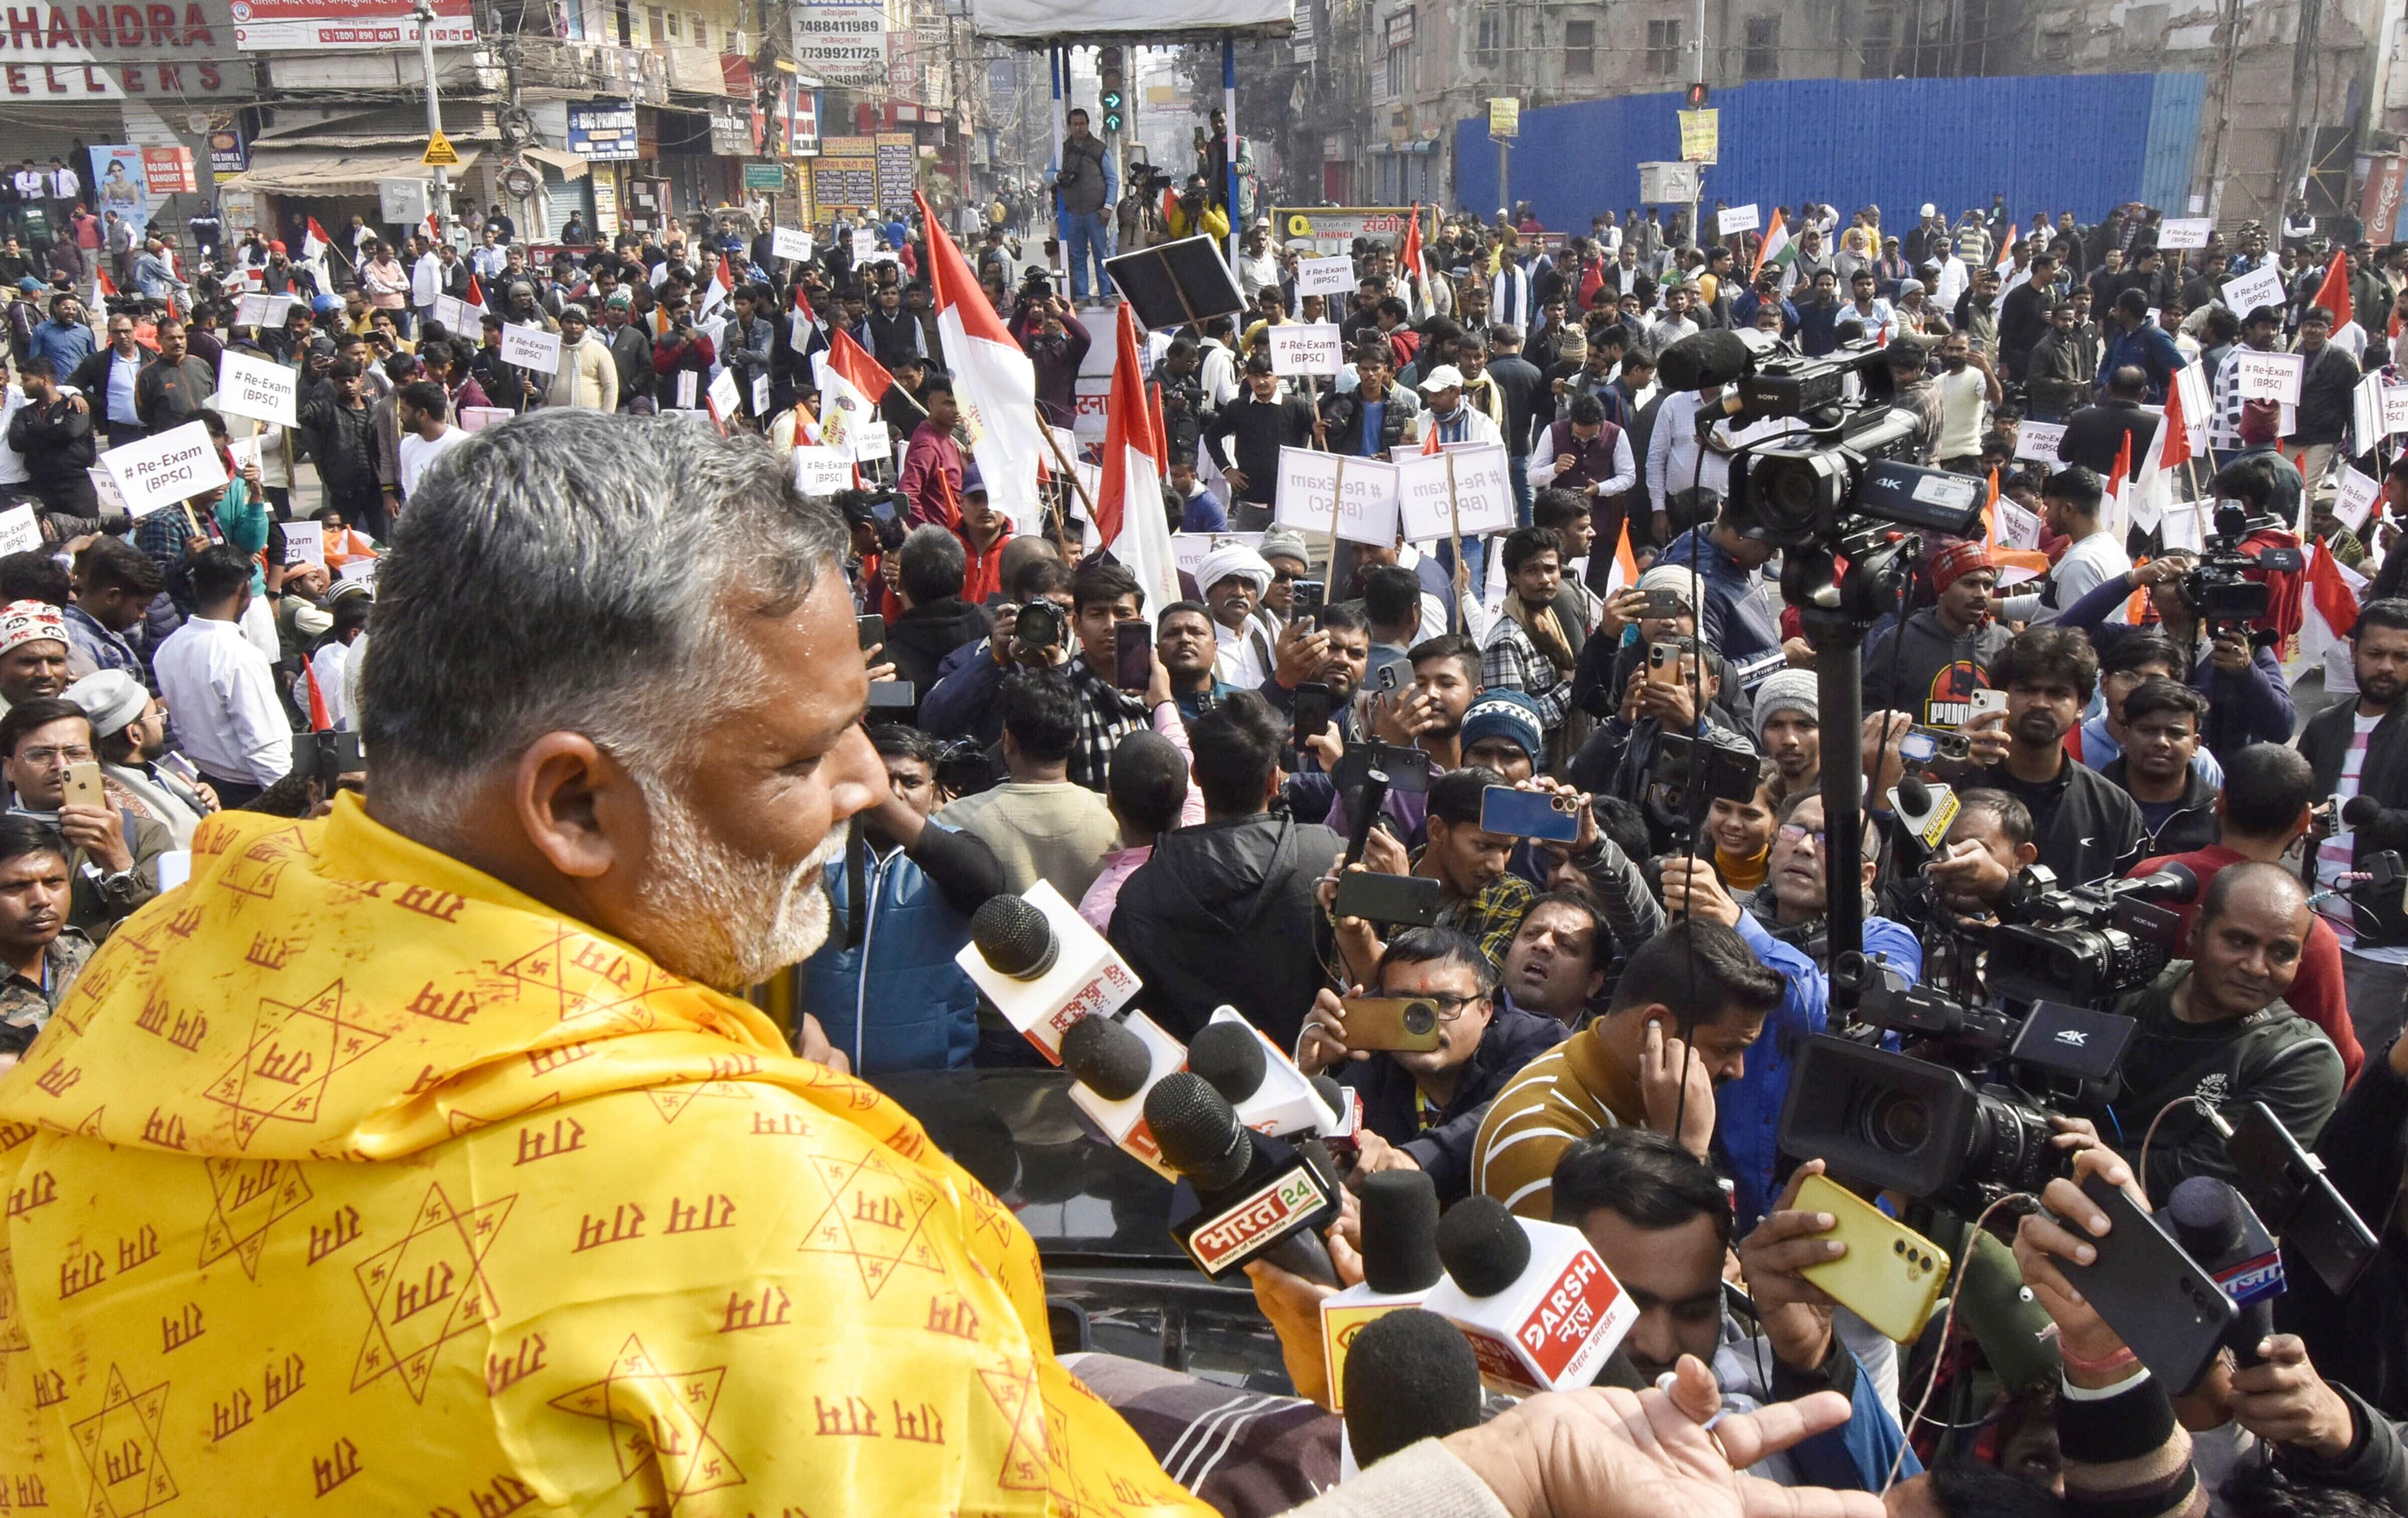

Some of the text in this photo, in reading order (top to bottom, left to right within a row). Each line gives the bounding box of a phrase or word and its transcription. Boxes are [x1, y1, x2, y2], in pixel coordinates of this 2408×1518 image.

[335, 30, 398, 40] 1800 890 6061
[800, 47, 879, 59] 7739921725
[579, 111, 636, 129] BIG PRINTING
[1316, 231, 1354, 239] FINANCE
[2171, 236, 2194, 245] (BPSC)
[2174, 229, 2203, 238] Re-Exam
[1312, 266, 1347, 275] Re-Exam
[1313, 275, 1339, 285] (BPSC)
[2233, 276, 2277, 298] # Re-Exam
[2244, 291, 2271, 307] (BPSC)
[515, 346, 542, 361] (BPSC)
[516, 337, 552, 352] Re-Exam
[1280, 340, 1335, 350] # Re-Exam
[1291, 353, 1325, 363] (BPSC)
[2245, 364, 2294, 378] # Re-Exam
[235, 370, 291, 395] # Re-Exam
[2252, 376, 2282, 391] (BPSC)
[243, 389, 279, 408] (BPSC)
[1076, 394, 1111, 416] टना
[2032, 443, 2058, 453] (BPSC
[2034, 433, 2061, 442] Re-Ex
[124, 444, 202, 479] # Re-Exam
[807, 460, 851, 470] # Re-Exam
[145, 467, 193, 494] (BPSC)
[815, 472, 843, 483] (BPSC)
[1875, 477, 1903, 490] 4K
[1948, 475, 1977, 485] SONY
[2005, 513, 2030, 535] Re-Exam
[4, 533, 28, 553] (BPSC)
[1925, 794, 1953, 837] TRENDING
[2058, 1029, 2089, 1044] 4K
[254, 1043, 313, 1086] राम
[751, 1112, 813, 1137] राम
[514, 1118, 588, 1167] राम
[663, 1194, 736, 1234] राम
[853, 1191, 905, 1230] राम
[1199, 1180, 1310, 1249] भारत 24
[307, 1206, 361, 1266] राम
[572, 1203, 645, 1254] राम
[118, 1225, 160, 1274] राम
[1214, 1220, 1287, 1266] Vision of New India
[391, 1262, 454, 1325] राम
[1524, 1253, 1598, 1351] DARSH
[719, 1287, 791, 1333] राम
[924, 1297, 980, 1340] राम
[163, 1303, 205, 1353] राम
[1567, 1311, 1617, 1377] बिहार झारखंड
[264, 1353, 304, 1412] राम
[213, 1389, 252, 1442] राम
[815, 1396, 881, 1436] राम
[894, 1400, 945, 1445] राम
[106, 1440, 143, 1485] राम
[314, 1438, 361, 1498] राम
